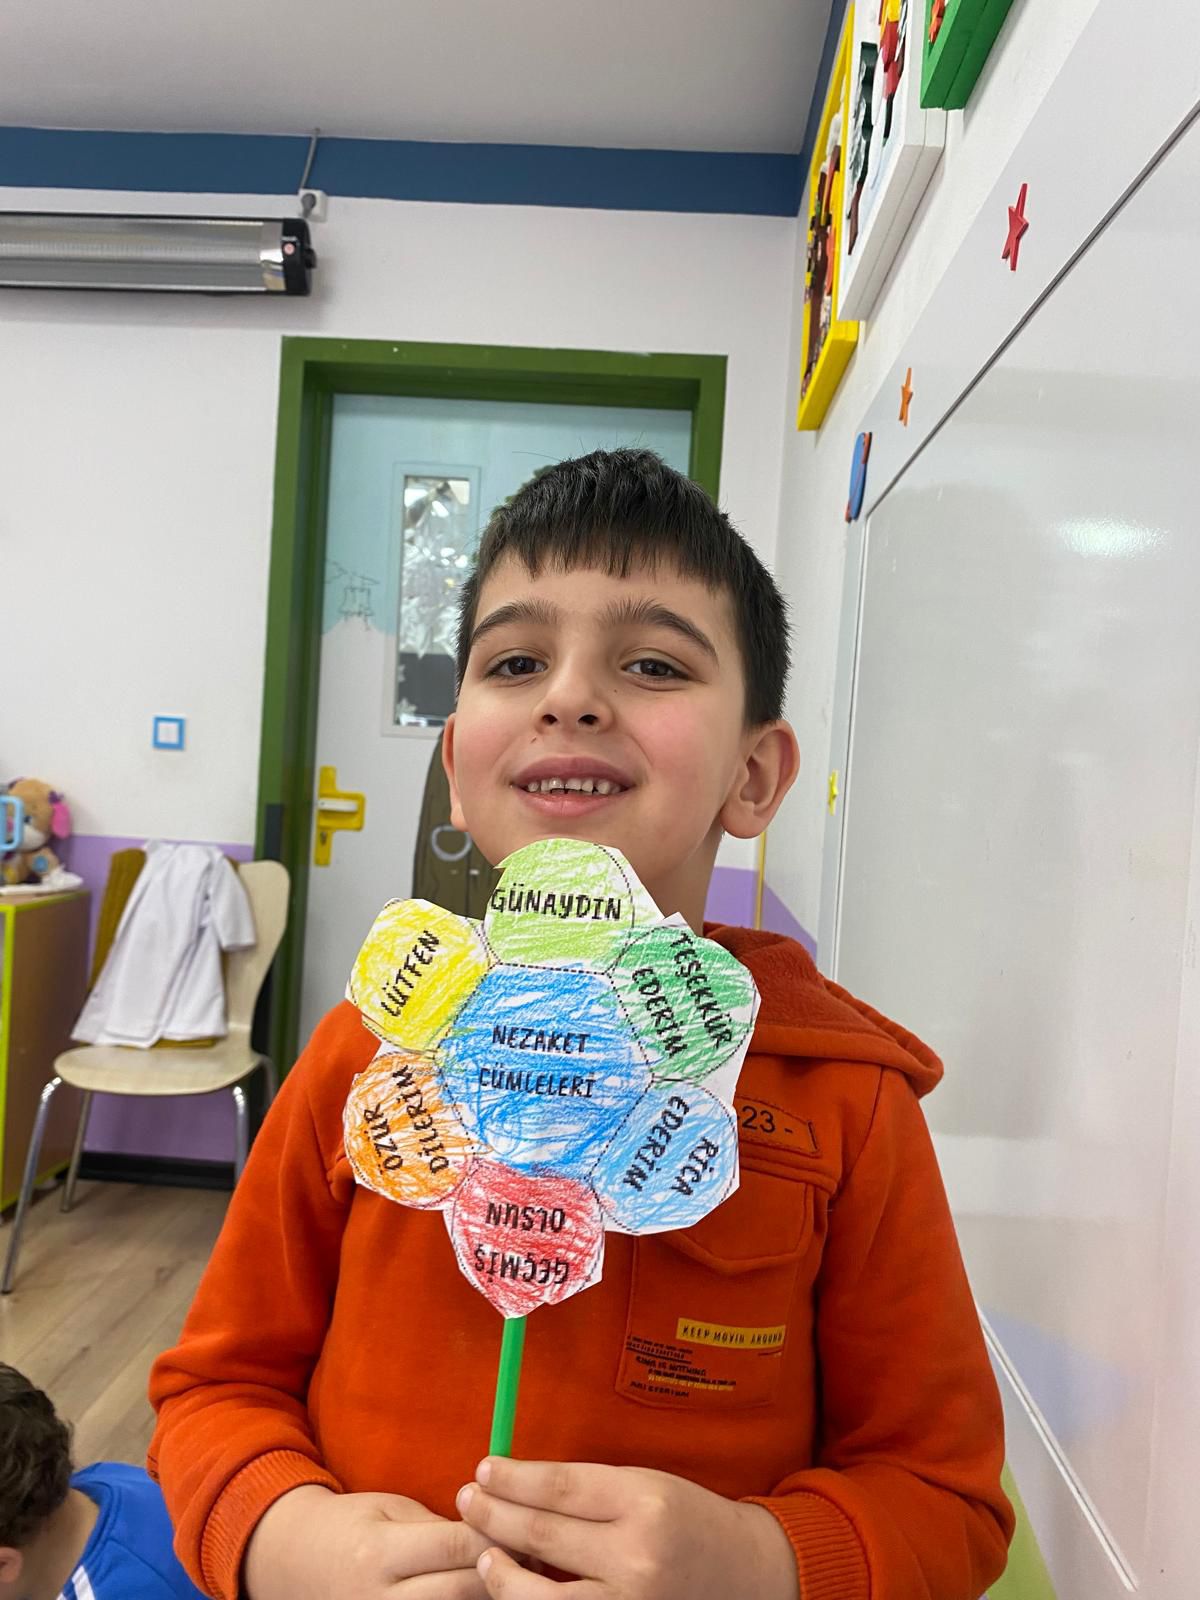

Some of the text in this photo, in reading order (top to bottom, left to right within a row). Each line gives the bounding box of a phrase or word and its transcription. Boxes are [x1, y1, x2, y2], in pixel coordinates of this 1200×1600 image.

[491, 883, 621, 920] GÜNAYDIN
[381, 930, 439, 1017] LÜTFEN
[670, 932, 732, 1049] TEŞEKKÜR
[492, 1025, 591, 1054] NEZAKET
[632, 968, 688, 1057] EDERİM
[480, 1062, 596, 1098] CÜMLELERİ
[363, 1103, 404, 1175] ÖZÜR
[392, 1065, 449, 1174] DİLERİM
[623, 1096, 690, 1192] EDERİM
[670, 1137, 719, 1195] RİCA
[485, 1203, 566, 1233] OLSUN
[474, 1244, 570, 1285] GEÇMİŞ
